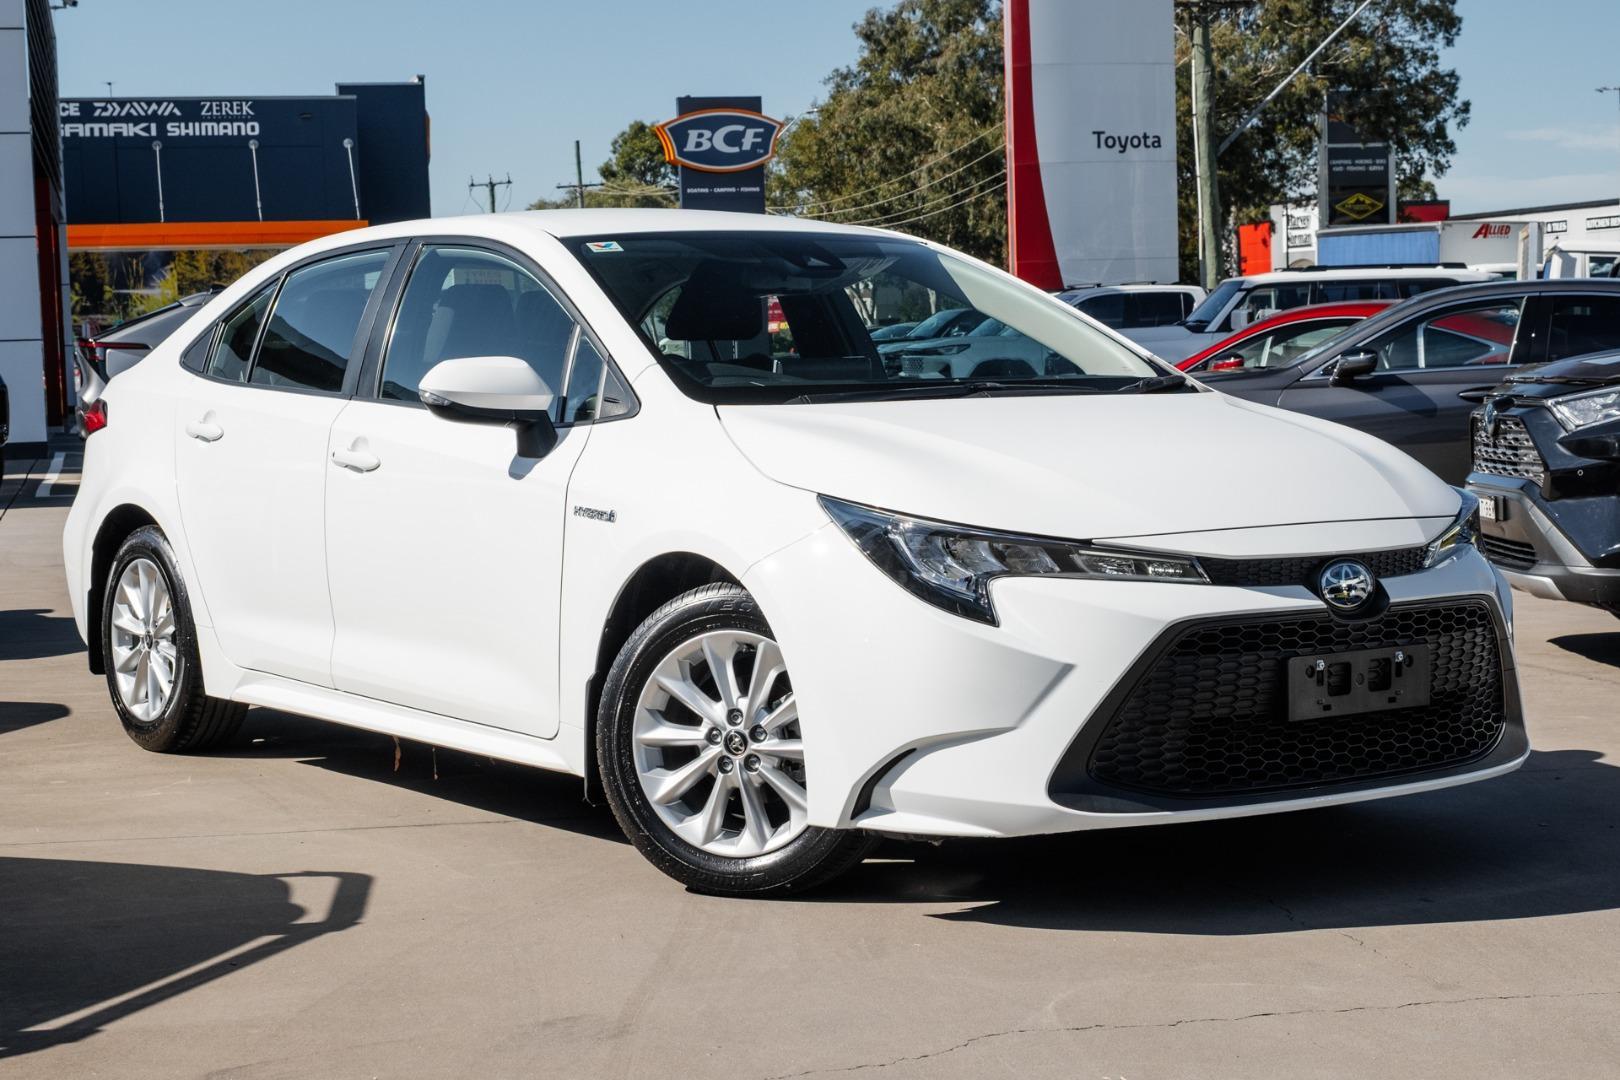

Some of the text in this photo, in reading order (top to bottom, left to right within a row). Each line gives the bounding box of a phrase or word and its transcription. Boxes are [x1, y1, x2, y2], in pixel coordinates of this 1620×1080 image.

[200, 101, 255, 116] ZEREK
[61, 122, 260, 137] AMAKI SHIMANO
[683, 125, 764, 153] BCF
[1092, 131, 1162, 154] Toyota
[1472, 223, 1511, 239] ALLIED
